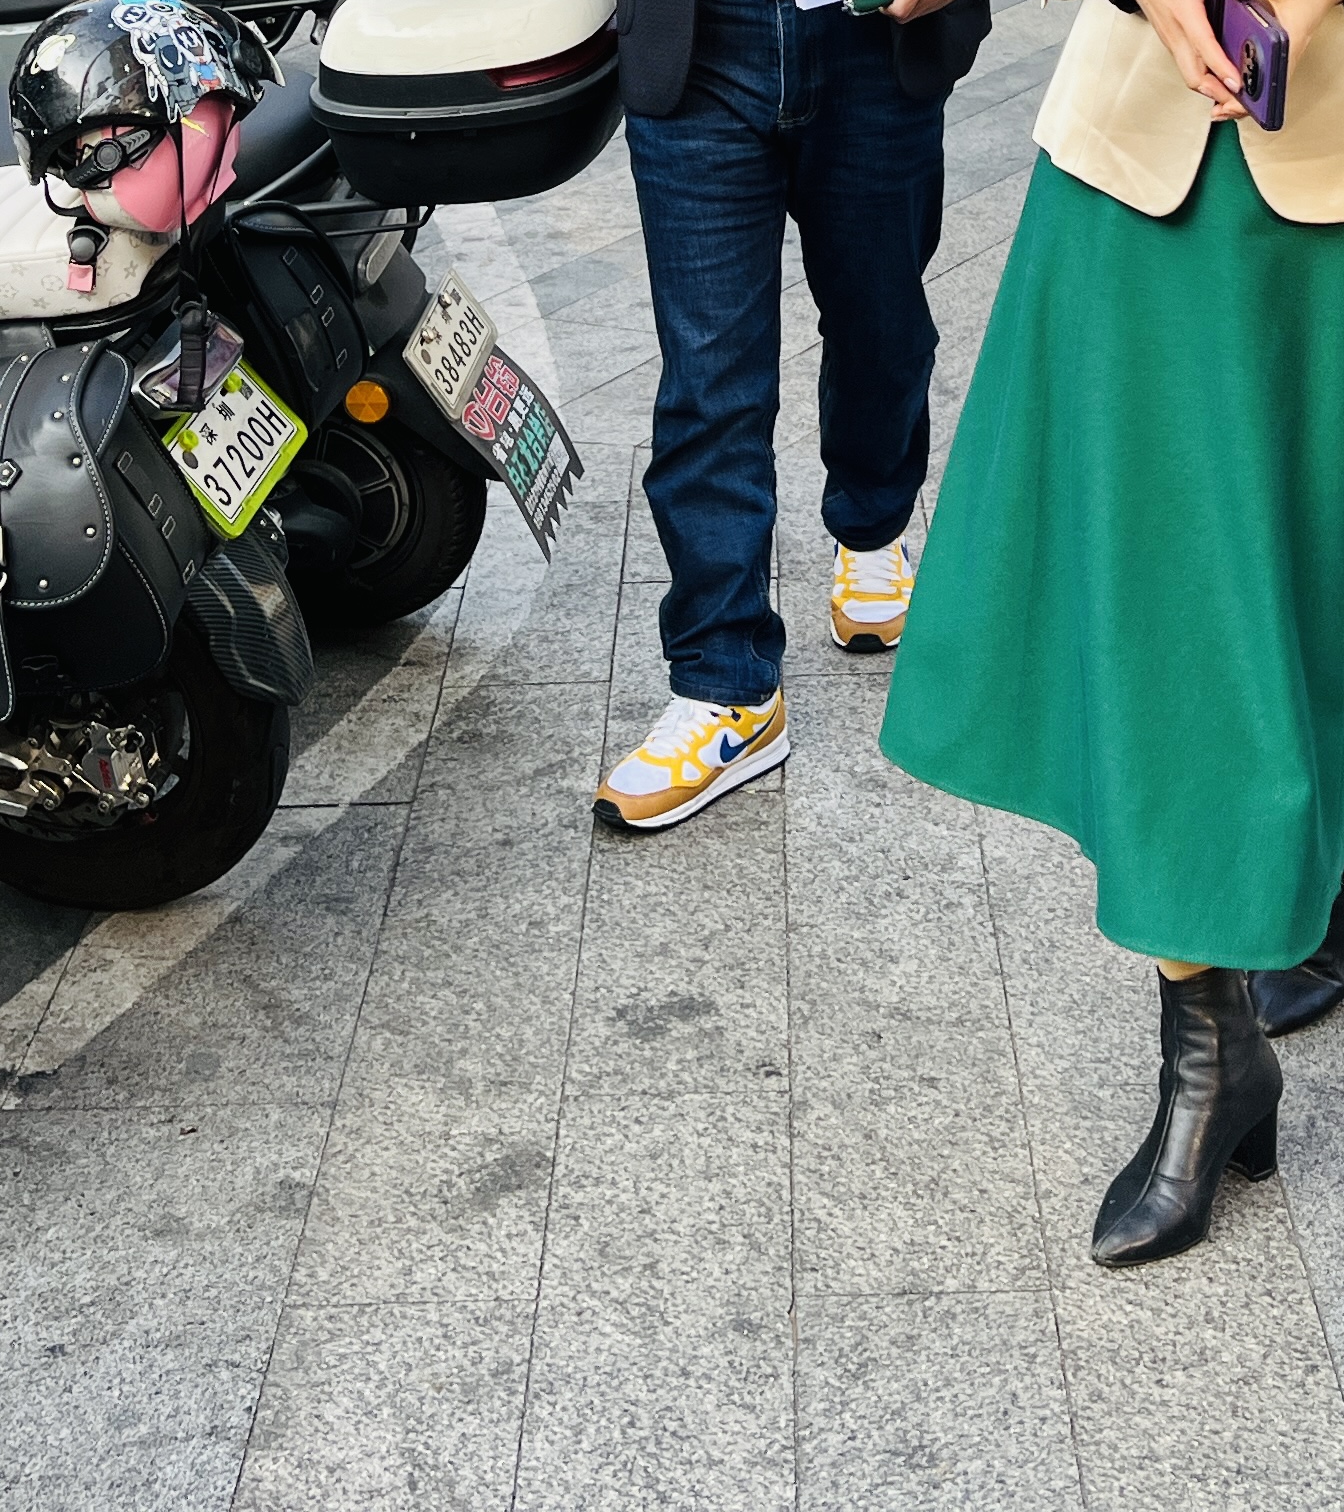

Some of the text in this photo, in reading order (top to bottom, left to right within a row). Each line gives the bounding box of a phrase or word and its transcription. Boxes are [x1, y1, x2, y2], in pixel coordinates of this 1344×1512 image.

[434, 306, 486, 395] 38483H
[199, 400, 236, 446] 深圳
[203, 399, 288, 507] 37200H
